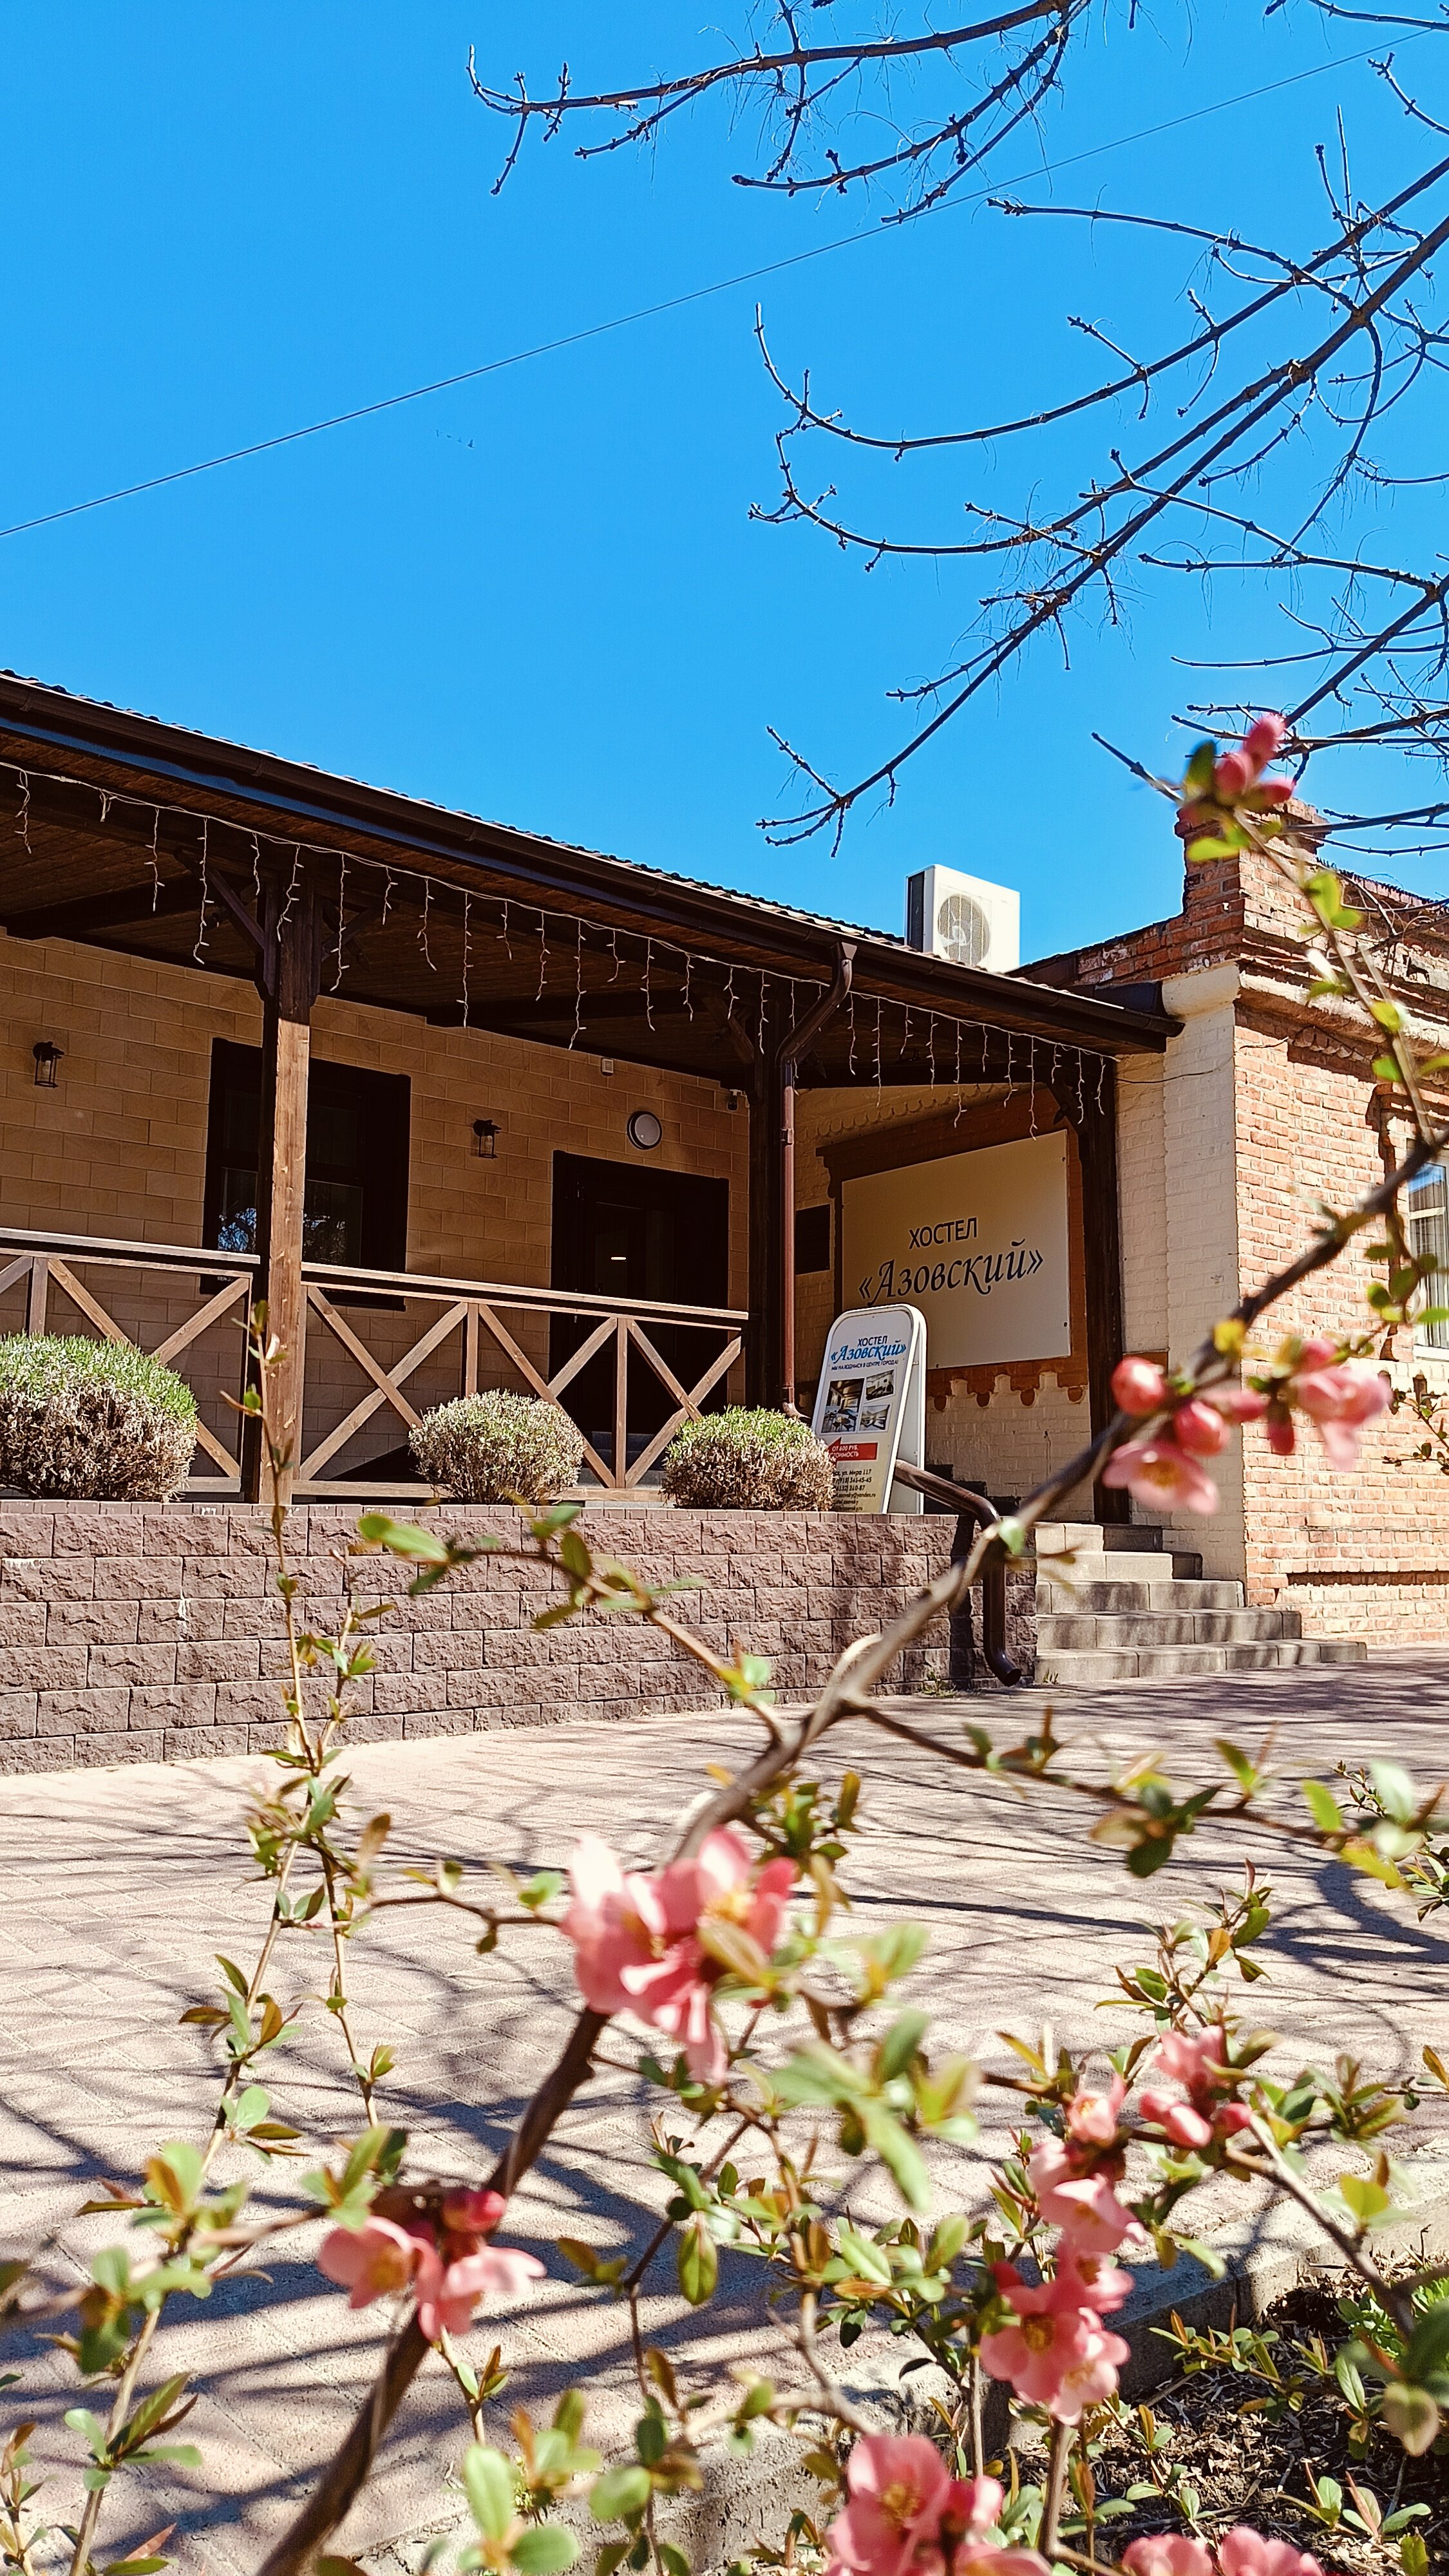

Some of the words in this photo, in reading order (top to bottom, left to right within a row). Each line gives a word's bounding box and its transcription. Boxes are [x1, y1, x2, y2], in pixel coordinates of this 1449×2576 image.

[909, 1217, 978, 1249] ХОСТЕЛ
[858, 1238, 1044, 1305] «Азовский»
[830, 1340, 907, 1364] «Азовский»
[857, 1335, 888, 1347] ХОСТЕЛ
